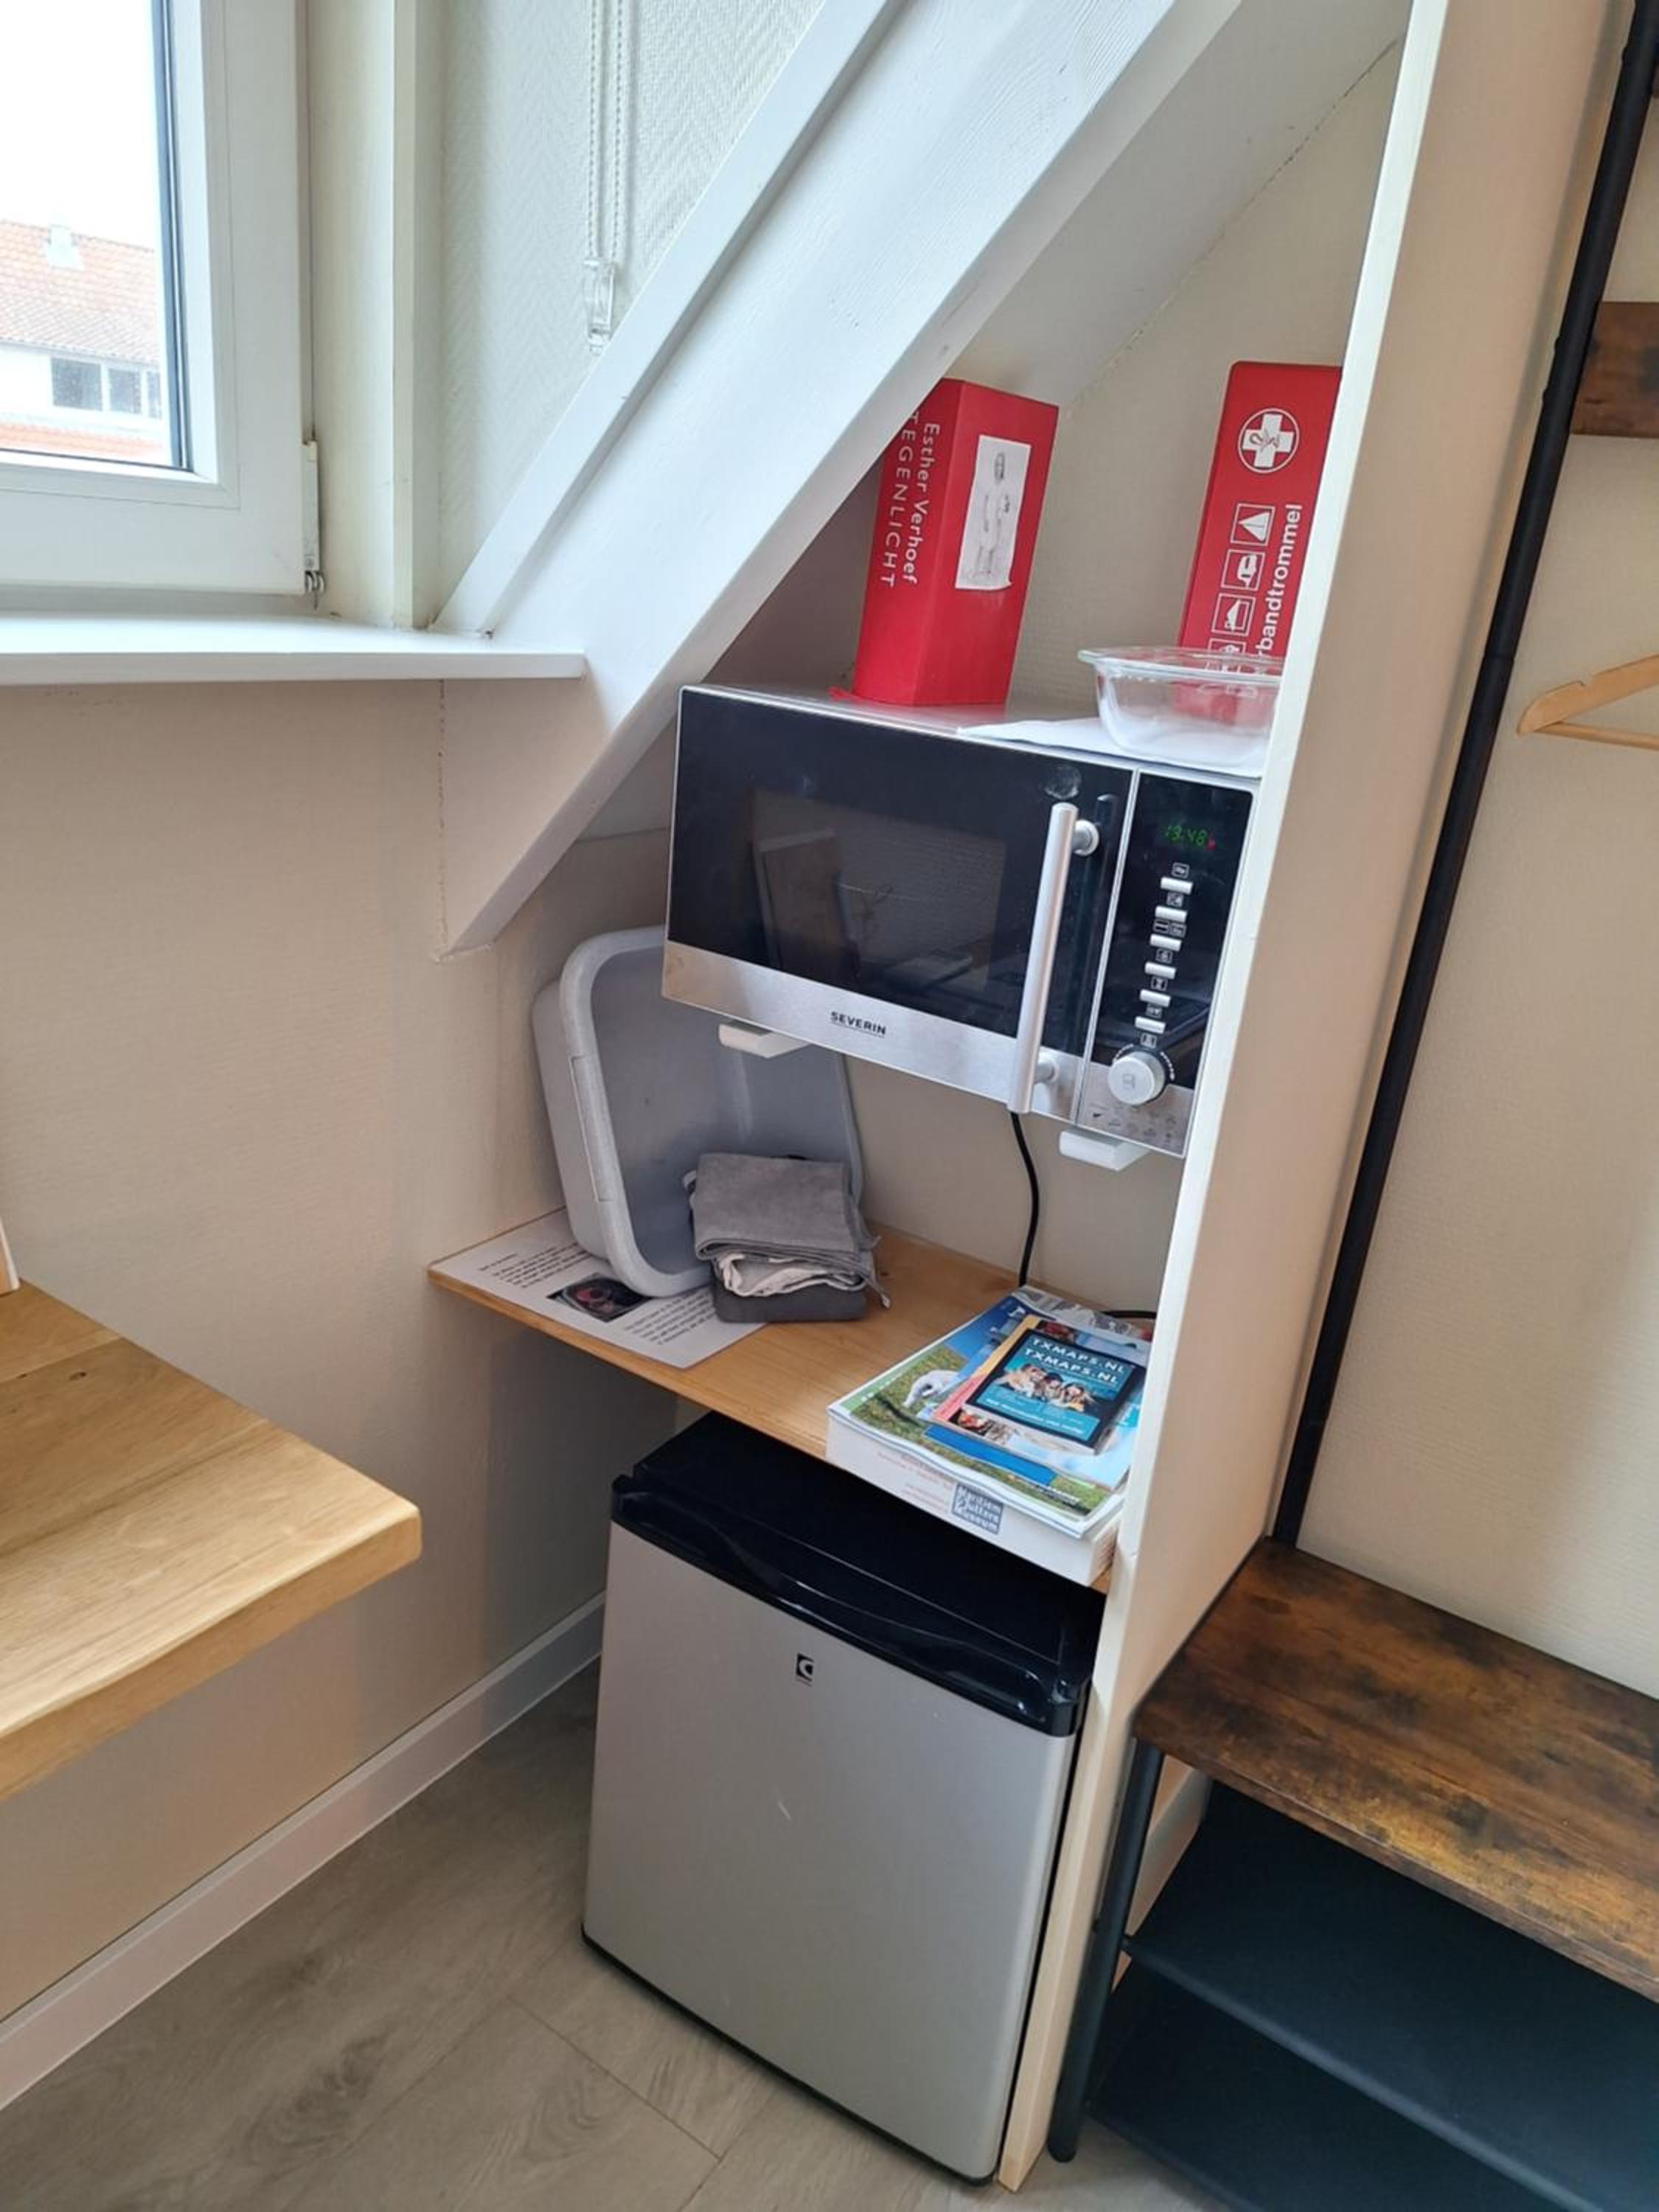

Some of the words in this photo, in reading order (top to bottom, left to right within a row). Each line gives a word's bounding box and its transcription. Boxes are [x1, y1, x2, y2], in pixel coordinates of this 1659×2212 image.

[917, 422, 941, 493] Esther
[880, 411, 919, 588] TEGENLICHT
[902, 499, 930, 585] Verhoef
[830, 1011, 886, 1034] SEVERIN
[1025, 1348, 1119, 1385] TXMAPS.NL
[1032, 1338, 1124, 1373] TXMAPS.NL
